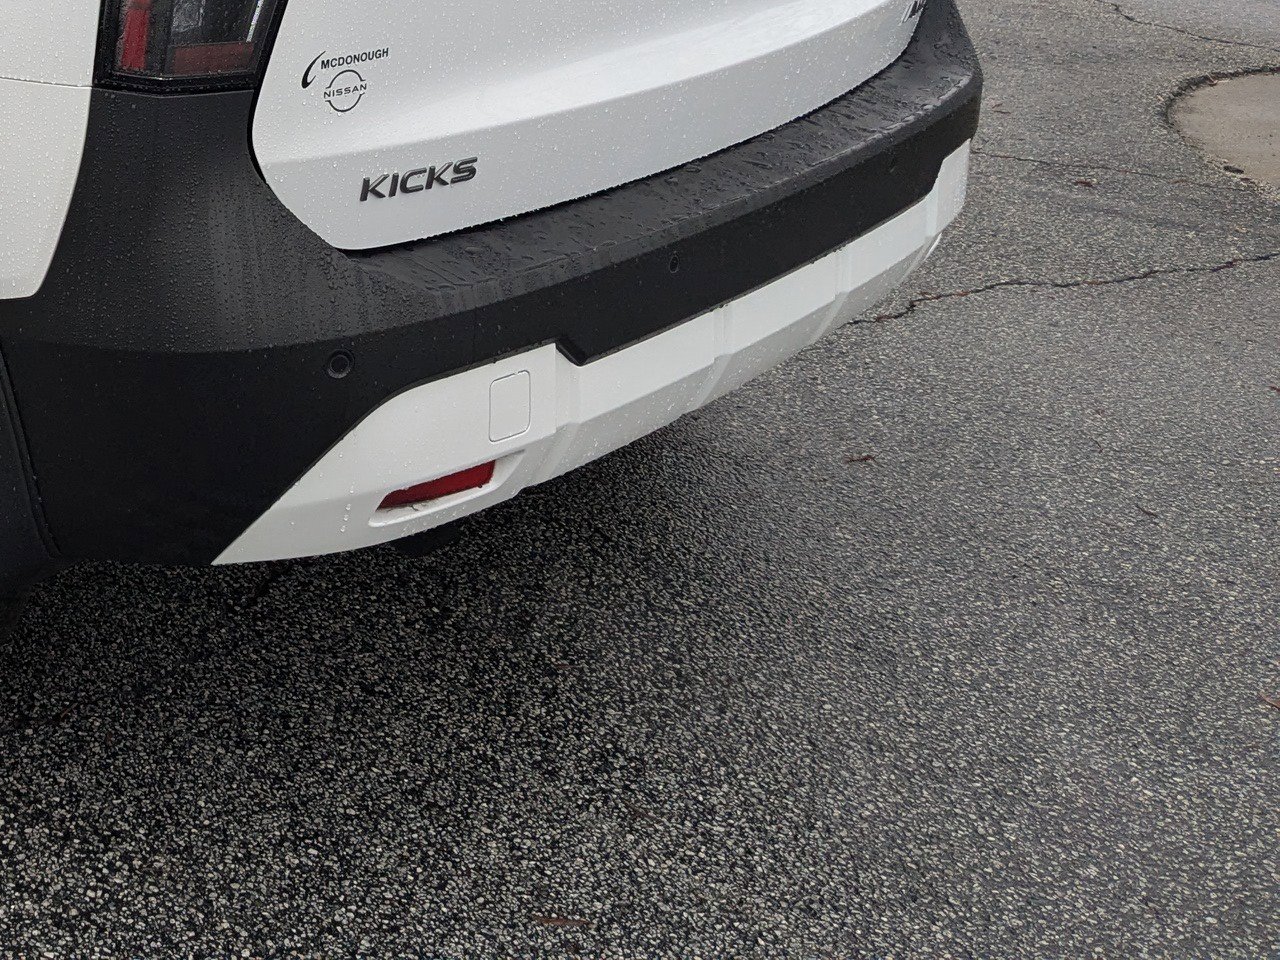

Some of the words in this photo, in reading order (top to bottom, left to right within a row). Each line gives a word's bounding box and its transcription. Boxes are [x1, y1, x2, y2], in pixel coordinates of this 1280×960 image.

[320, 47, 390, 70] MCDONOUGH
[323, 83, 368, 100] NISSAN
[359, 156, 478, 202] KICKS
